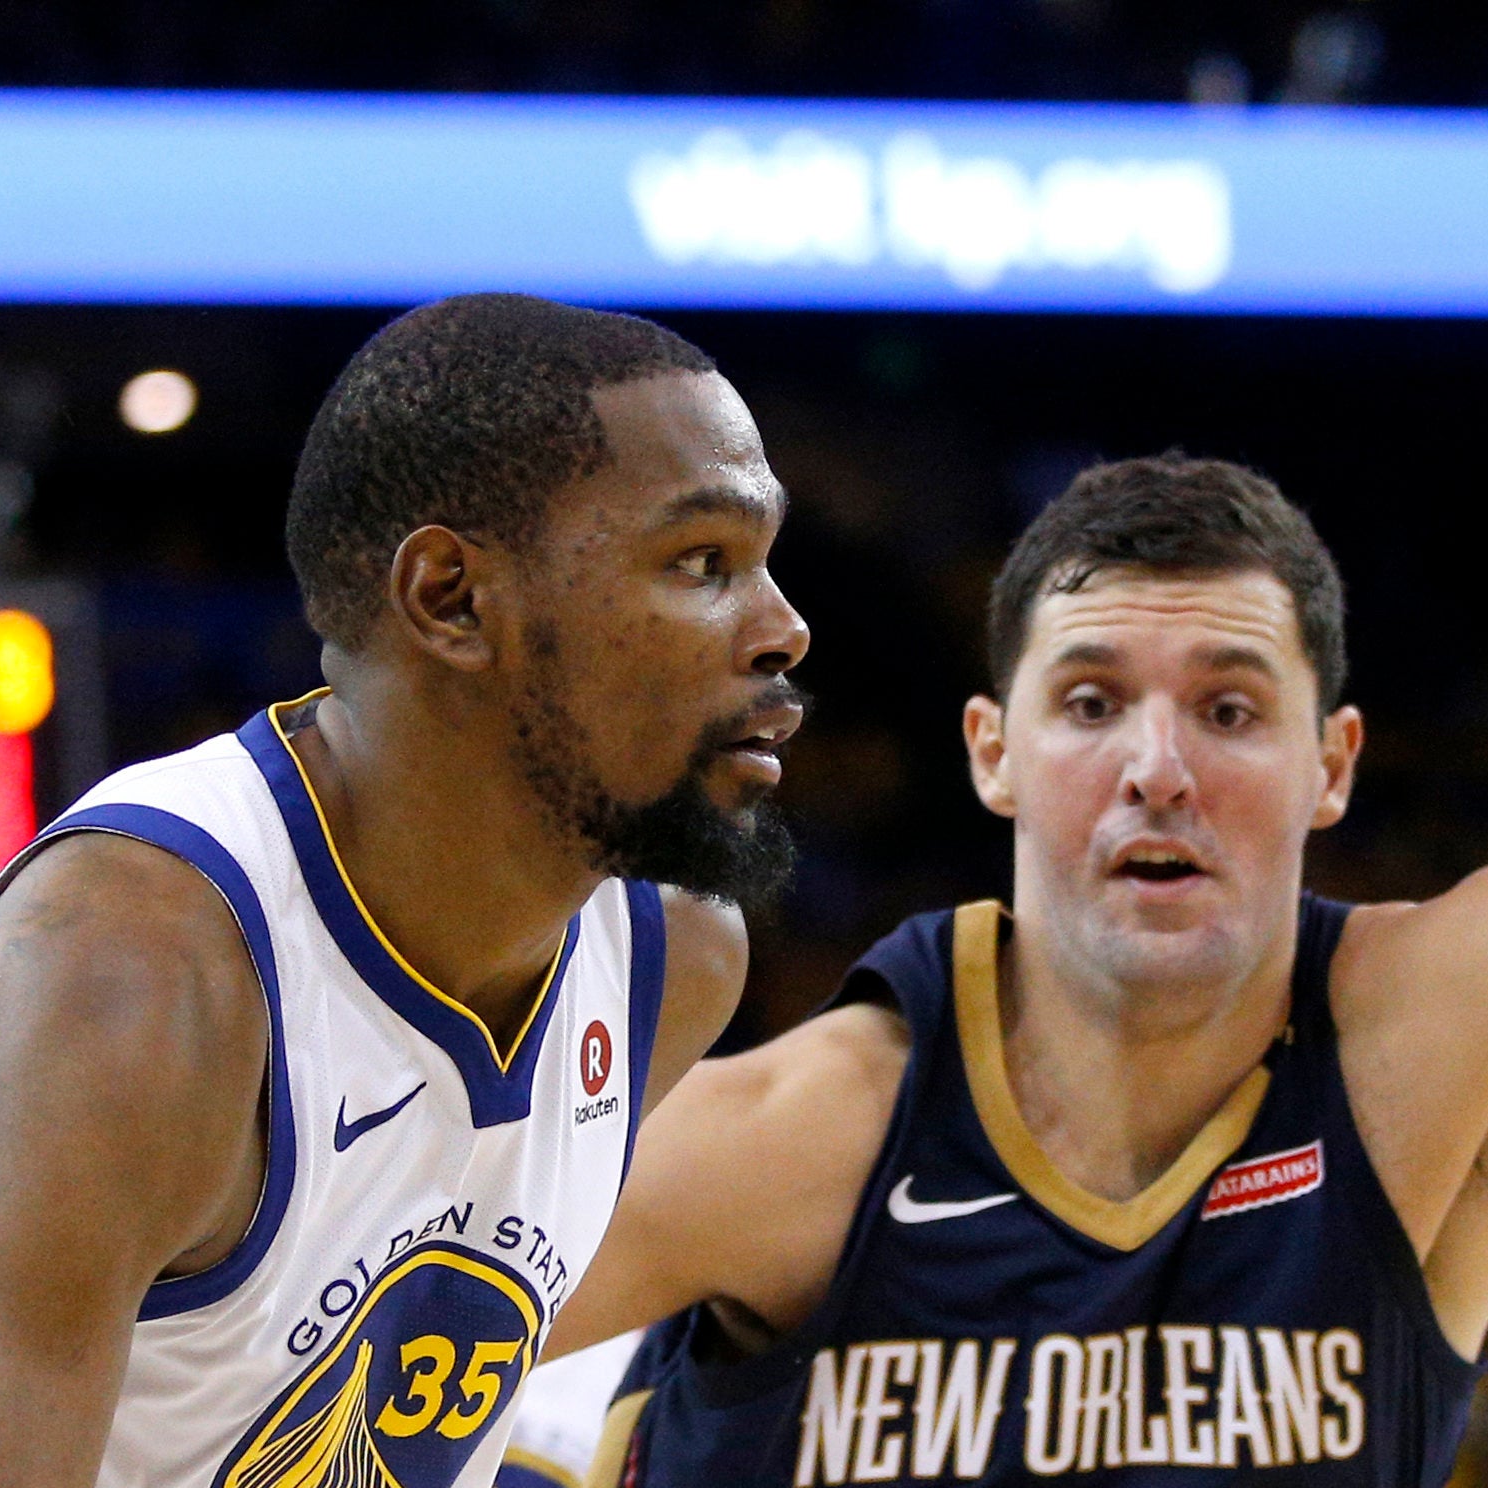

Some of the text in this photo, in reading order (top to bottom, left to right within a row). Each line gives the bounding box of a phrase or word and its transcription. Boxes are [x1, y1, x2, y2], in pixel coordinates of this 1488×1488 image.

[574, 1096, 619, 1126] Rakuten
[374, 1333, 524, 1441] 35
[1022, 1325, 1365, 1476] ORLEANS
